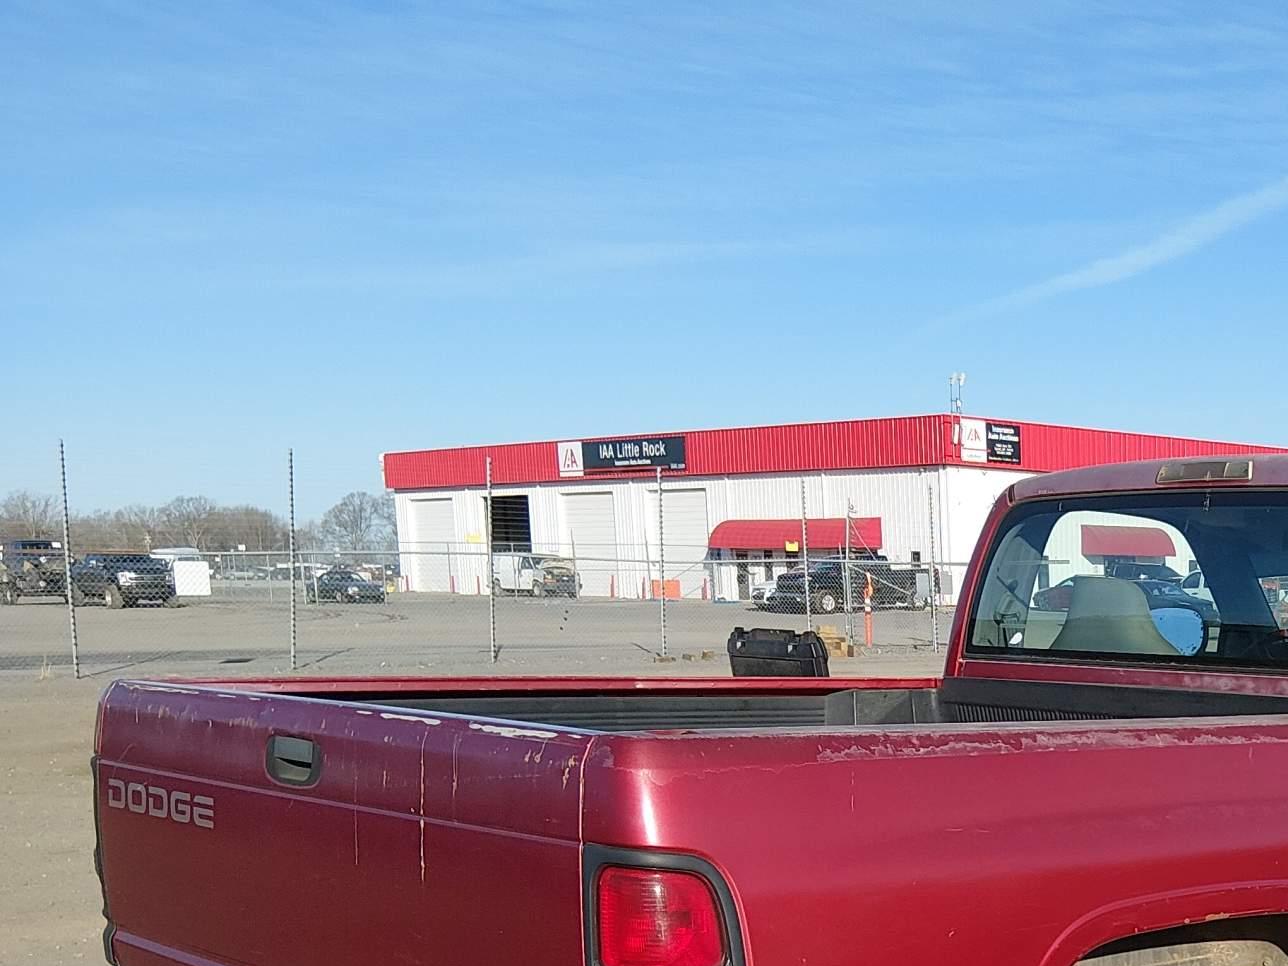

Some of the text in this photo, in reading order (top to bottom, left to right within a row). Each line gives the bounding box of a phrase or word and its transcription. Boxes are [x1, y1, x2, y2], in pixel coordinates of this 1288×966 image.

[599, 440, 667, 459] IAA Little Rock
[108, 778, 215, 830] DODGE
